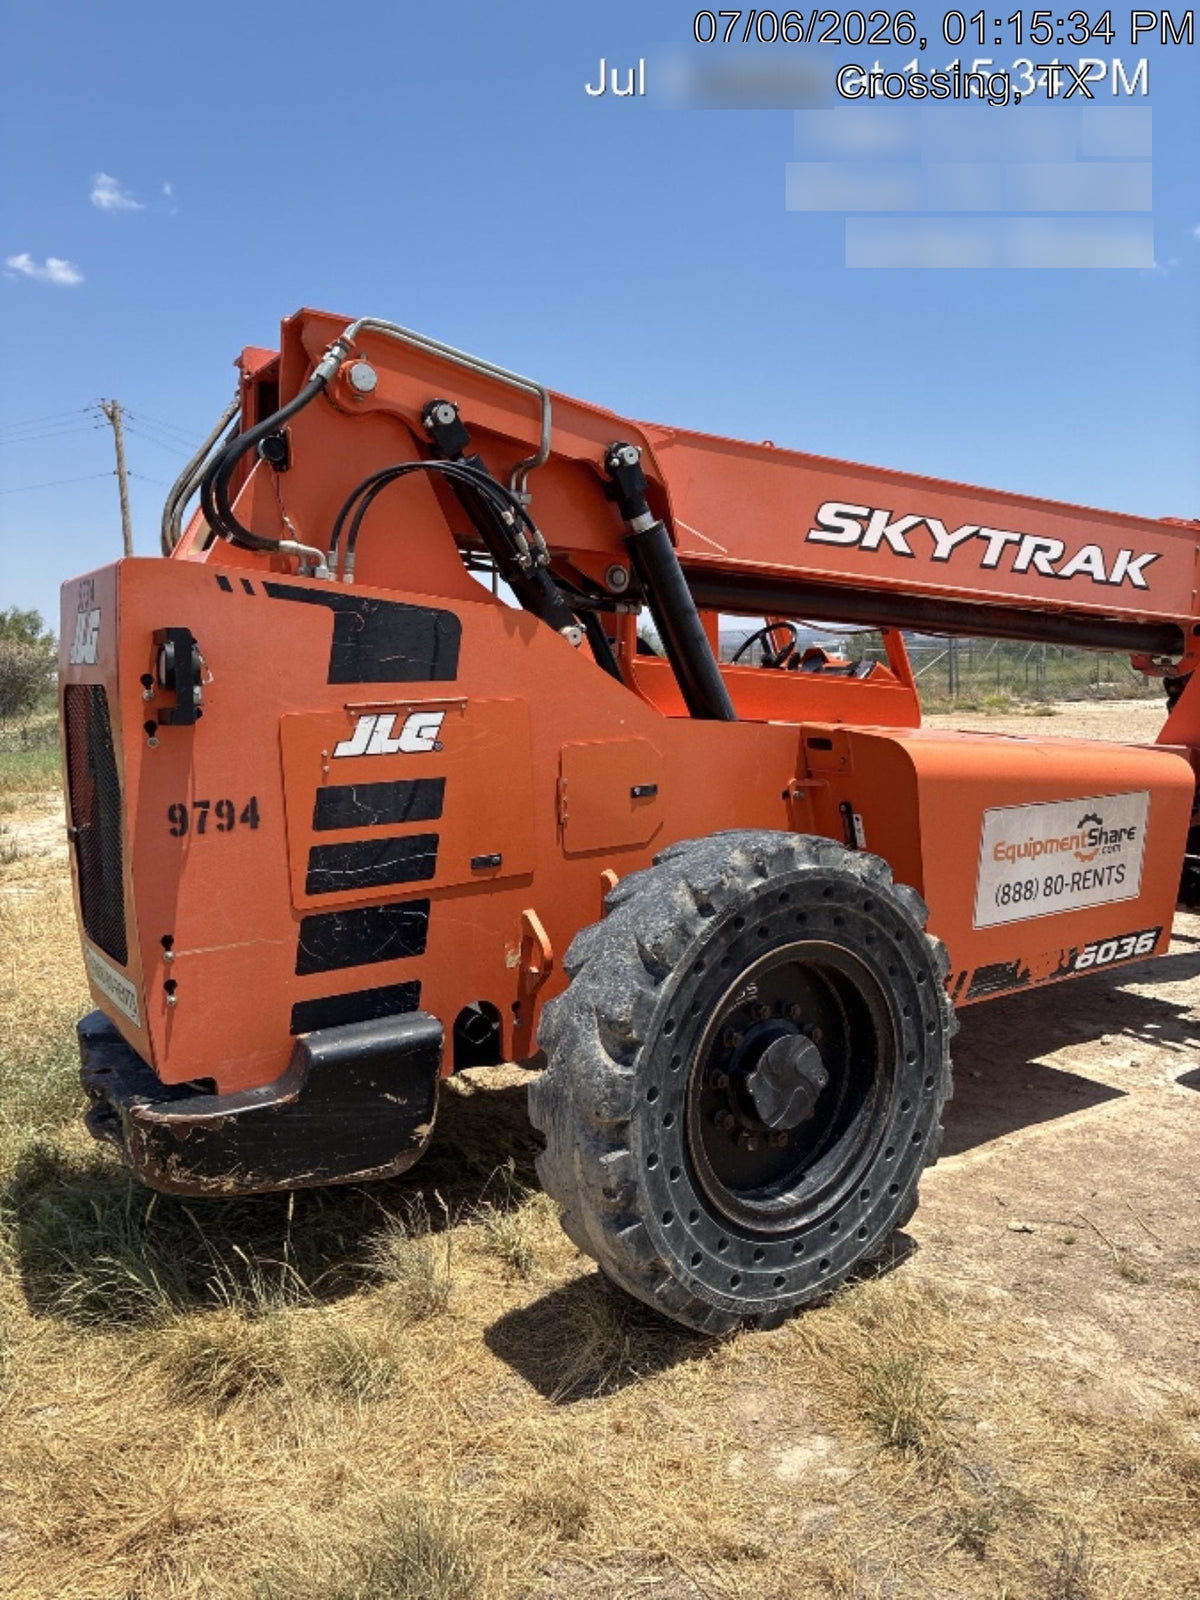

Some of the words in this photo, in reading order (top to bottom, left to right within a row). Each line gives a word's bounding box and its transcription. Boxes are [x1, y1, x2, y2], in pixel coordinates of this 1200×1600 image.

[806, 500, 1162, 590] SKYTRAK
[168, 796, 260, 837] 9794
[995, 876, 1039, 907] (888)
[1043, 863, 1126, 897] 80-RENTS
[1075, 930, 1157, 970] 6036
